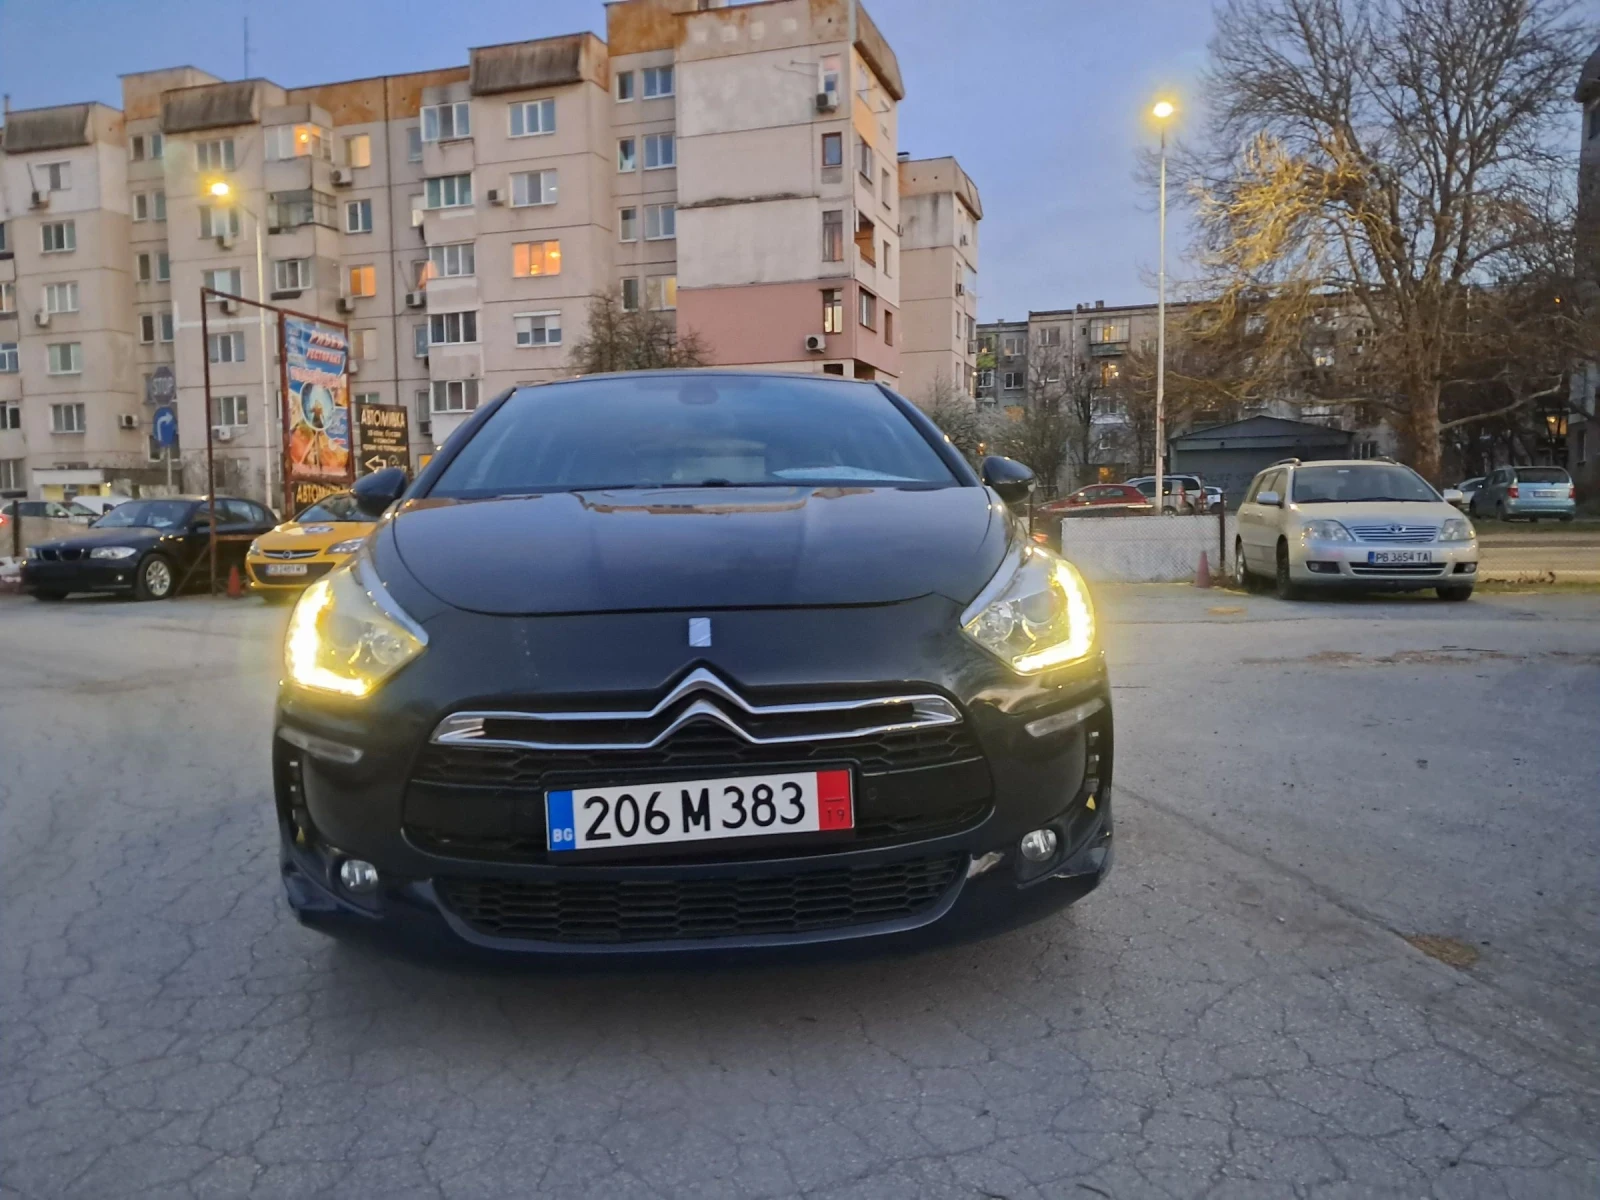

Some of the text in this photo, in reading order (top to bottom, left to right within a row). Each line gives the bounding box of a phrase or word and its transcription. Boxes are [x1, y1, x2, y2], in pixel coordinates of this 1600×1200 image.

[361, 408, 405, 428] АВТОМИВКА
[583, 781, 806, 841] 206 M 383
[553, 827, 573, 842] BG
